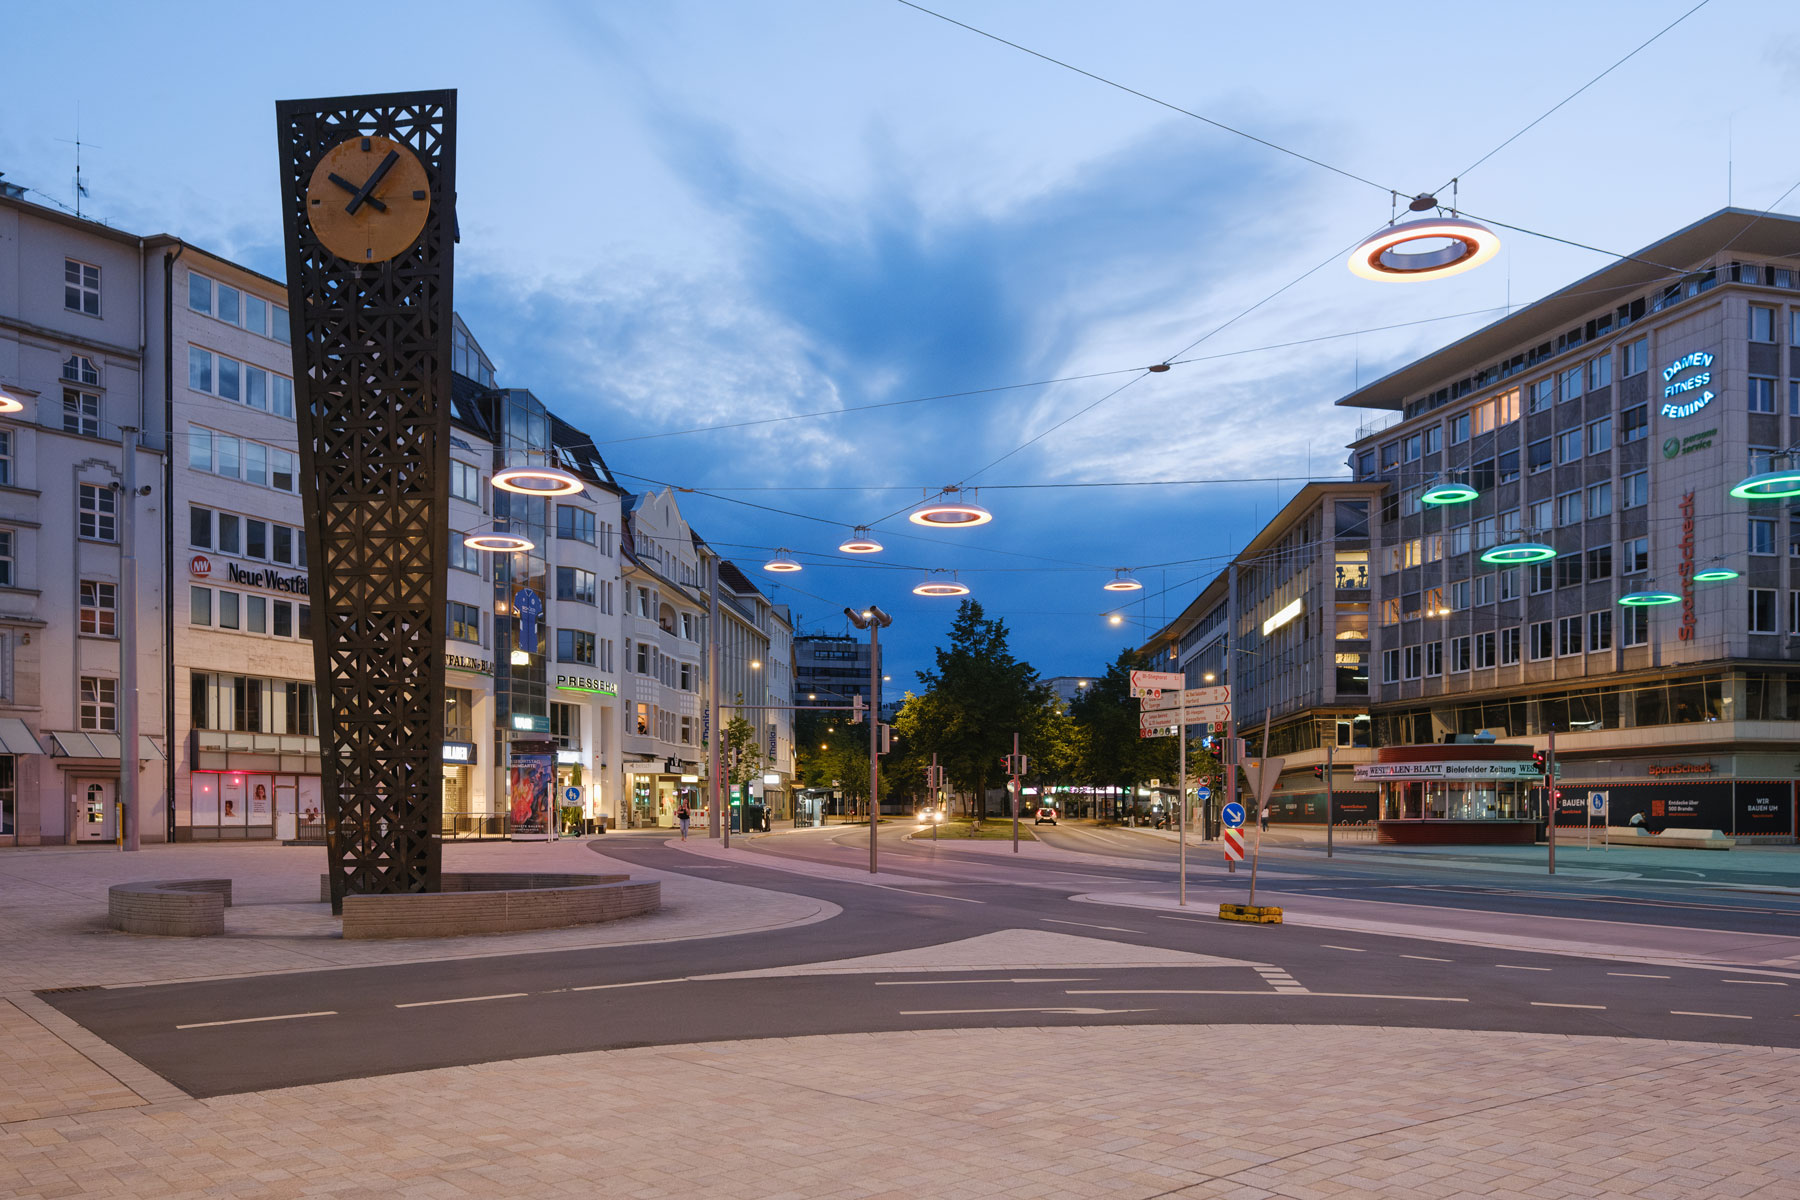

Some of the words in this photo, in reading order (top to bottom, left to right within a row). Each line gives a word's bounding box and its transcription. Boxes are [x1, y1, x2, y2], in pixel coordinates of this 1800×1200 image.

[1663, 352, 1714, 382] DAMEN
[1664, 372, 1711, 398] FITNESS
[1661, 390, 1715, 419] FEMINA
[193, 561, 209, 572] NW
[228, 562, 263, 588] Neue
[1678, 491, 1697, 641] SportScheck
[557, 675, 618, 693] PRESSEHA
[1446, 765, 1487, 774] Bielefelder
[1489, 765, 1516, 775] Zeitung
[1648, 762, 1712, 776] SportScheck
[1562, 798, 1585, 807] BAUEN
